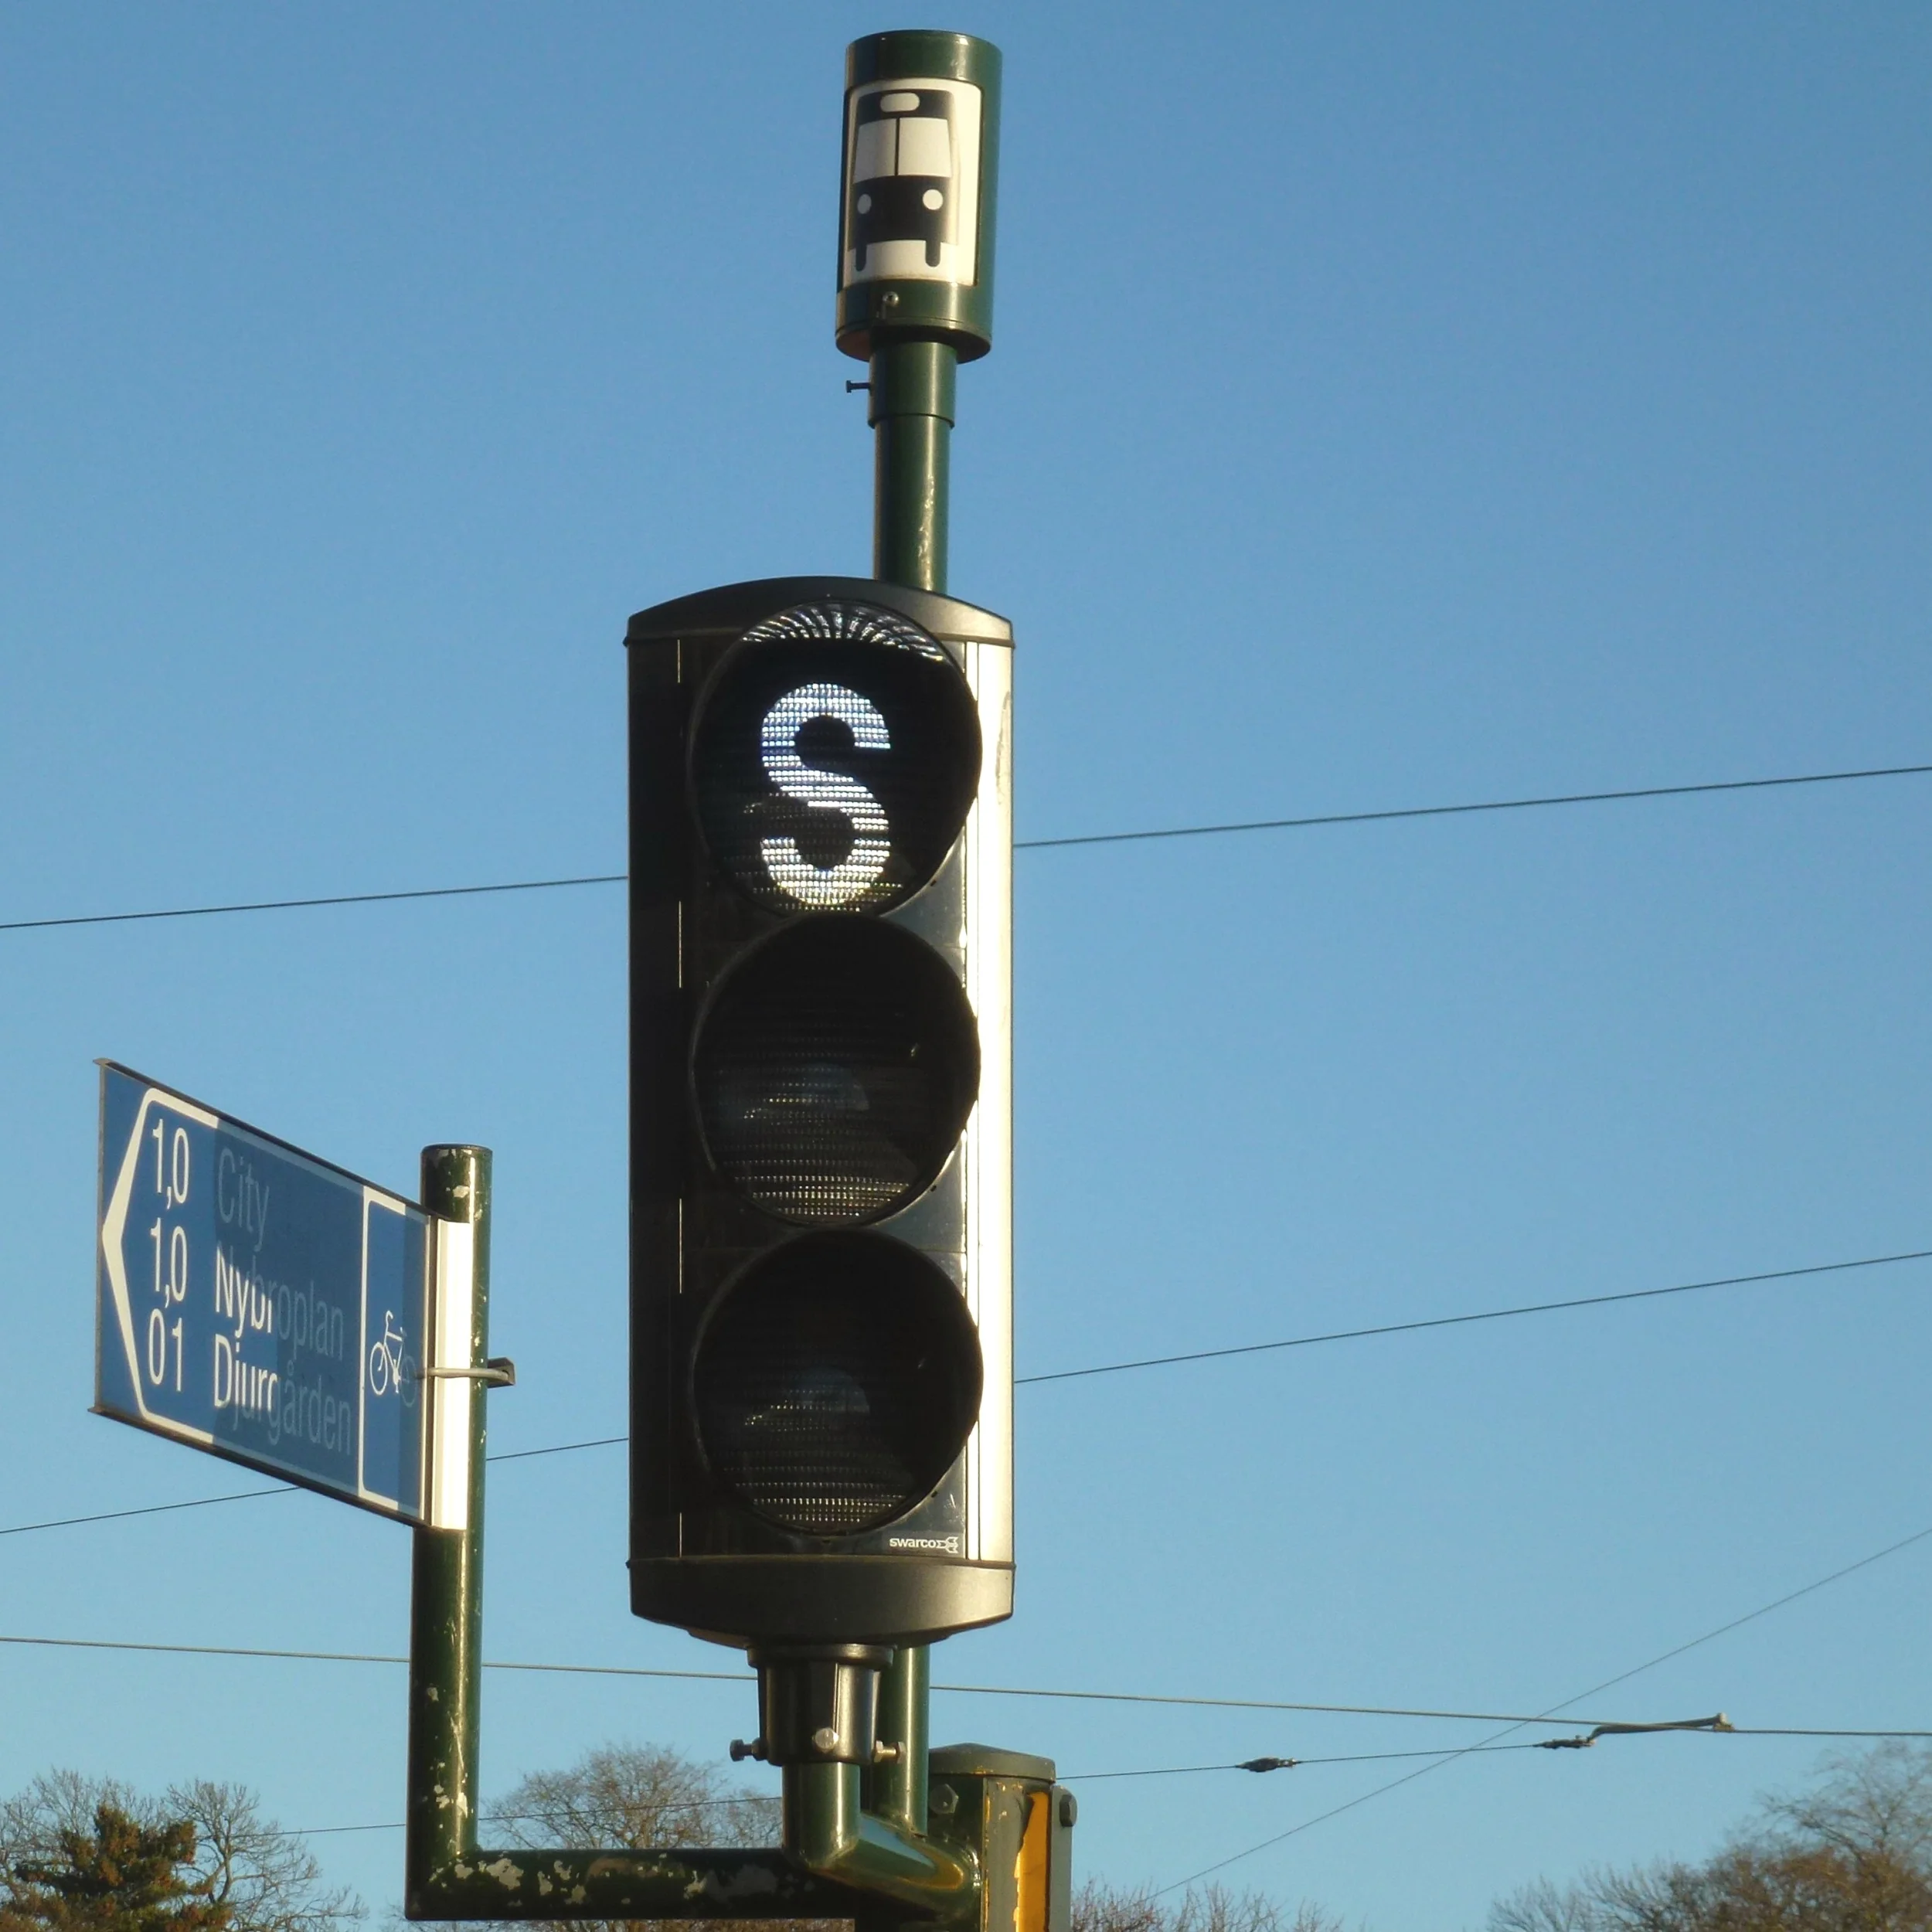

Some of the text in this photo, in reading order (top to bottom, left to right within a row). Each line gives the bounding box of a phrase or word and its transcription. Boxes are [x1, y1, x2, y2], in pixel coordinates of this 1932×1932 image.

[761, 682, 890, 905] S
[151, 1117, 270, 1252] 1,0 City
[150, 1216, 345, 1362] 1,0 Nybroplan
[213, 1333, 352, 1456] Djurgården
[889, 1538, 937, 1549] swarco
